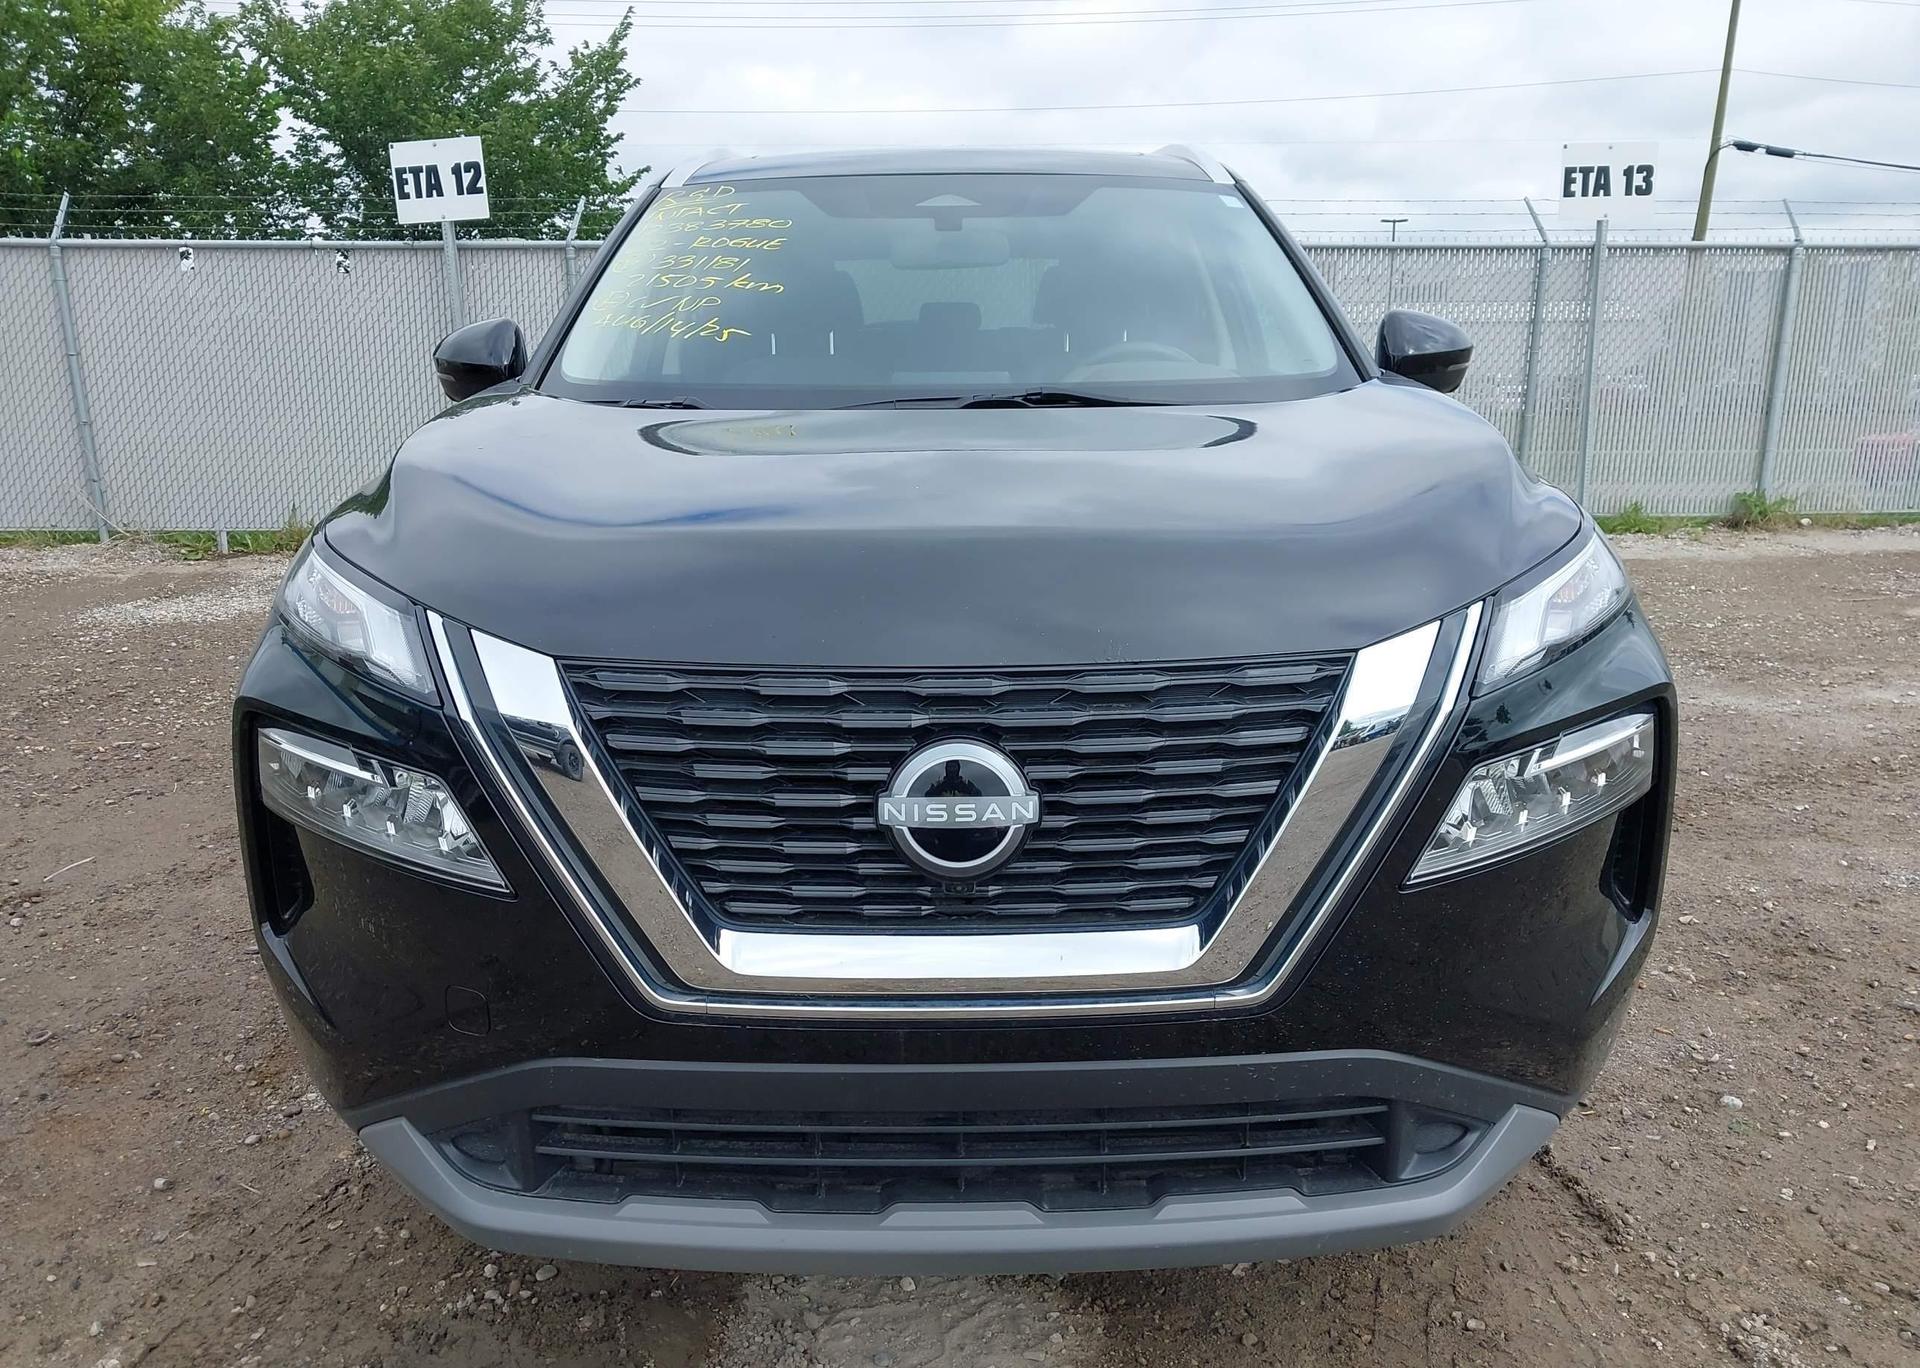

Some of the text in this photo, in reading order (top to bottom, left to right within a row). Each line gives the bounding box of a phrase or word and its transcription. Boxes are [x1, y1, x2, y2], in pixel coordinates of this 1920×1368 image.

[395, 161, 484, 200] ETA 12
[1563, 165, 1654, 198] ETA 13
[884, 801, 1033, 822] NISSAN
